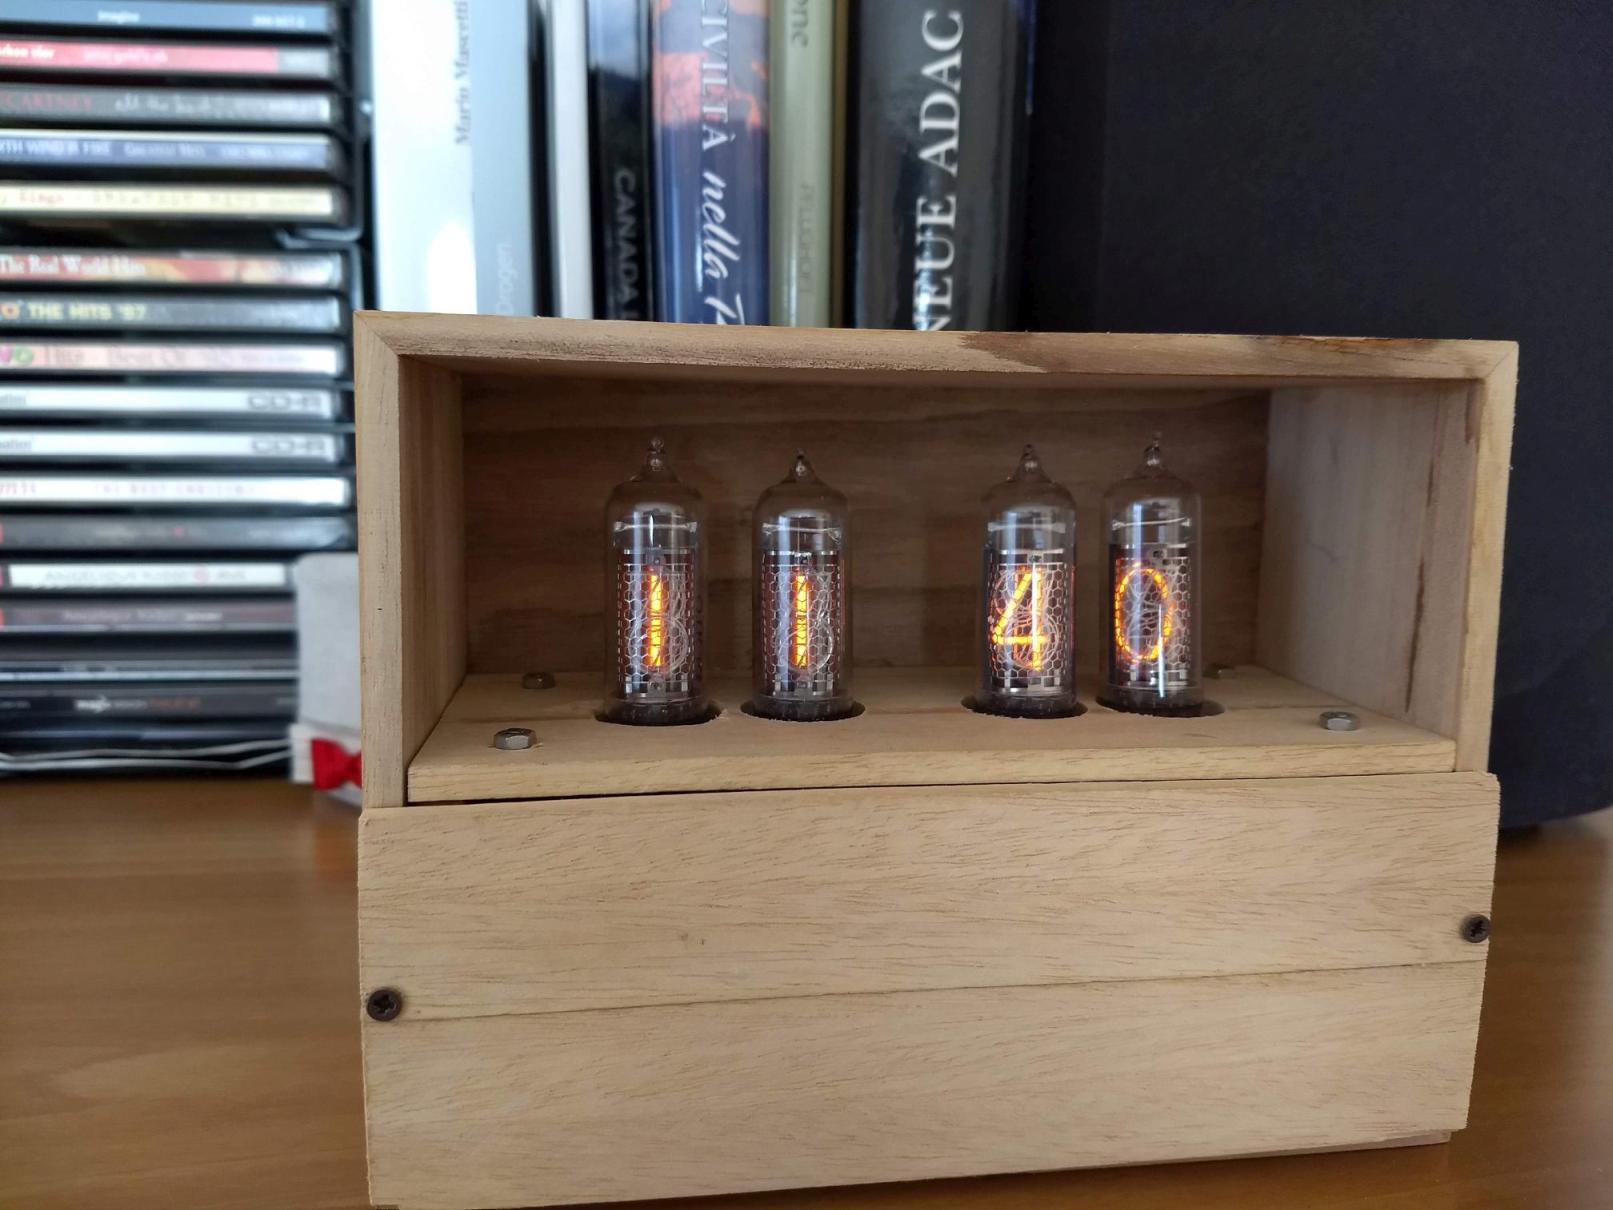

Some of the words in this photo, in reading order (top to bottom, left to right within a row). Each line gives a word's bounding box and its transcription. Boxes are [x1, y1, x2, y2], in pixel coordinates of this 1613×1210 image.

[918, 9, 964, 178] ADAC
[615, 167, 640, 304] CANADA
[702, 171, 741, 281] nella
[28, 302, 63, 320] THE
[68, 302, 112, 320] HITS
[648, 566, 664, 668] 1
[794, 573, 809, 668] 1
[993, 568, 1045, 671] 4
[1115, 563, 1173, 661] 0
